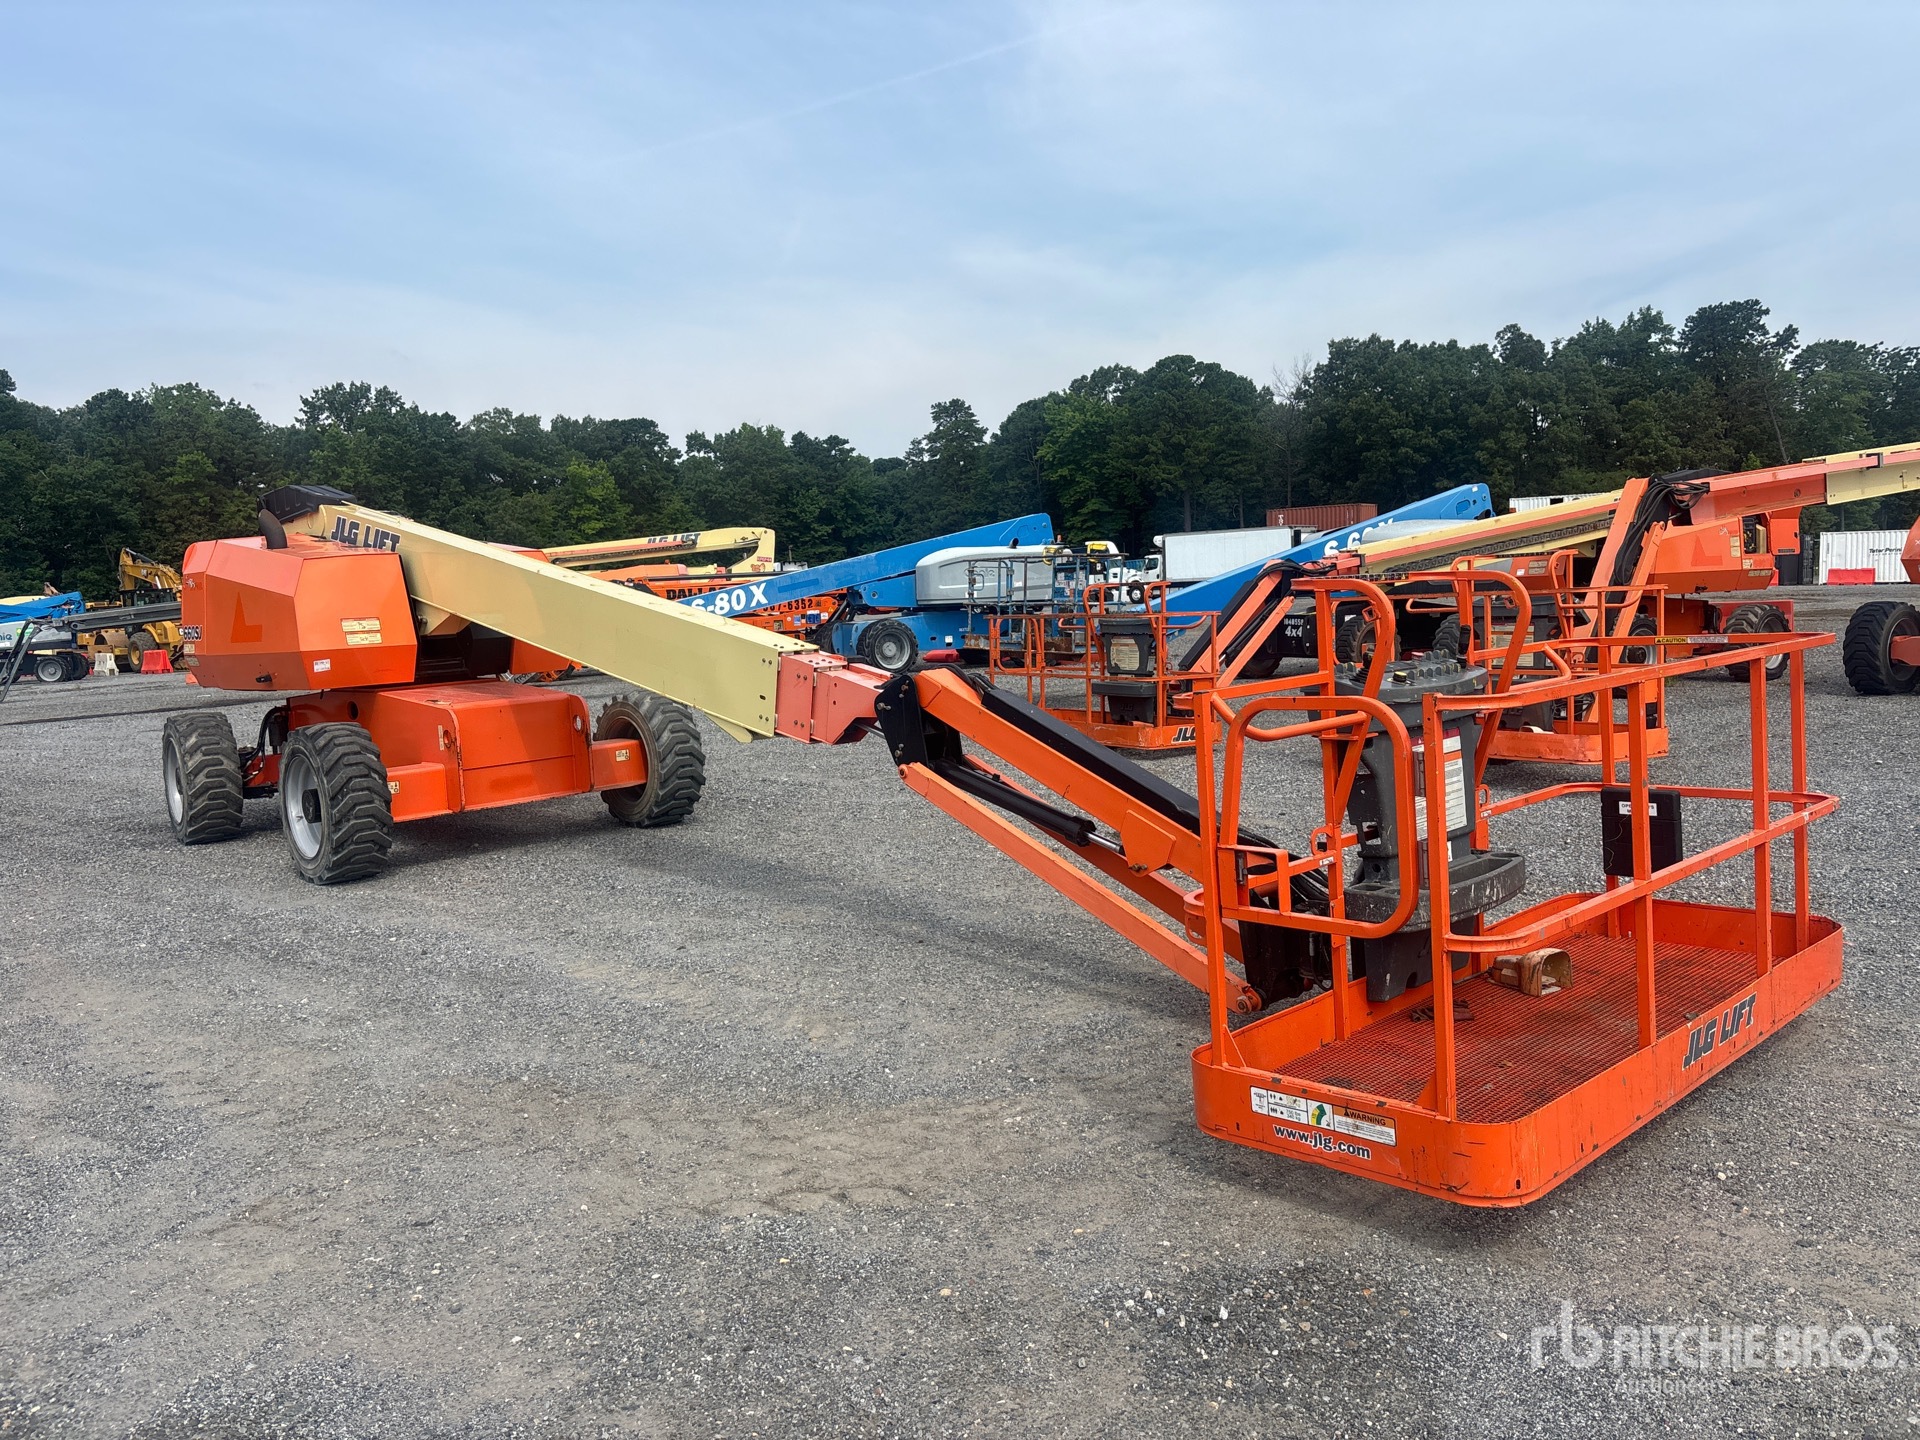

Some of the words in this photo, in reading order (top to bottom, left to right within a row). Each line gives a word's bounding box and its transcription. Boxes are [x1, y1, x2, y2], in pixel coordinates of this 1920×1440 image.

[331, 515, 361, 546] JLG
[363, 524, 401, 553] LIFT
[1285, 626, 1302, 637] 4x4
[1682, 1016, 1719, 1071] JLG
[1719, 991, 1757, 1047] LIFT
[1350, 1110, 1386, 1126] WARNING
[1273, 1125, 1371, 1160] www.jlg.com
